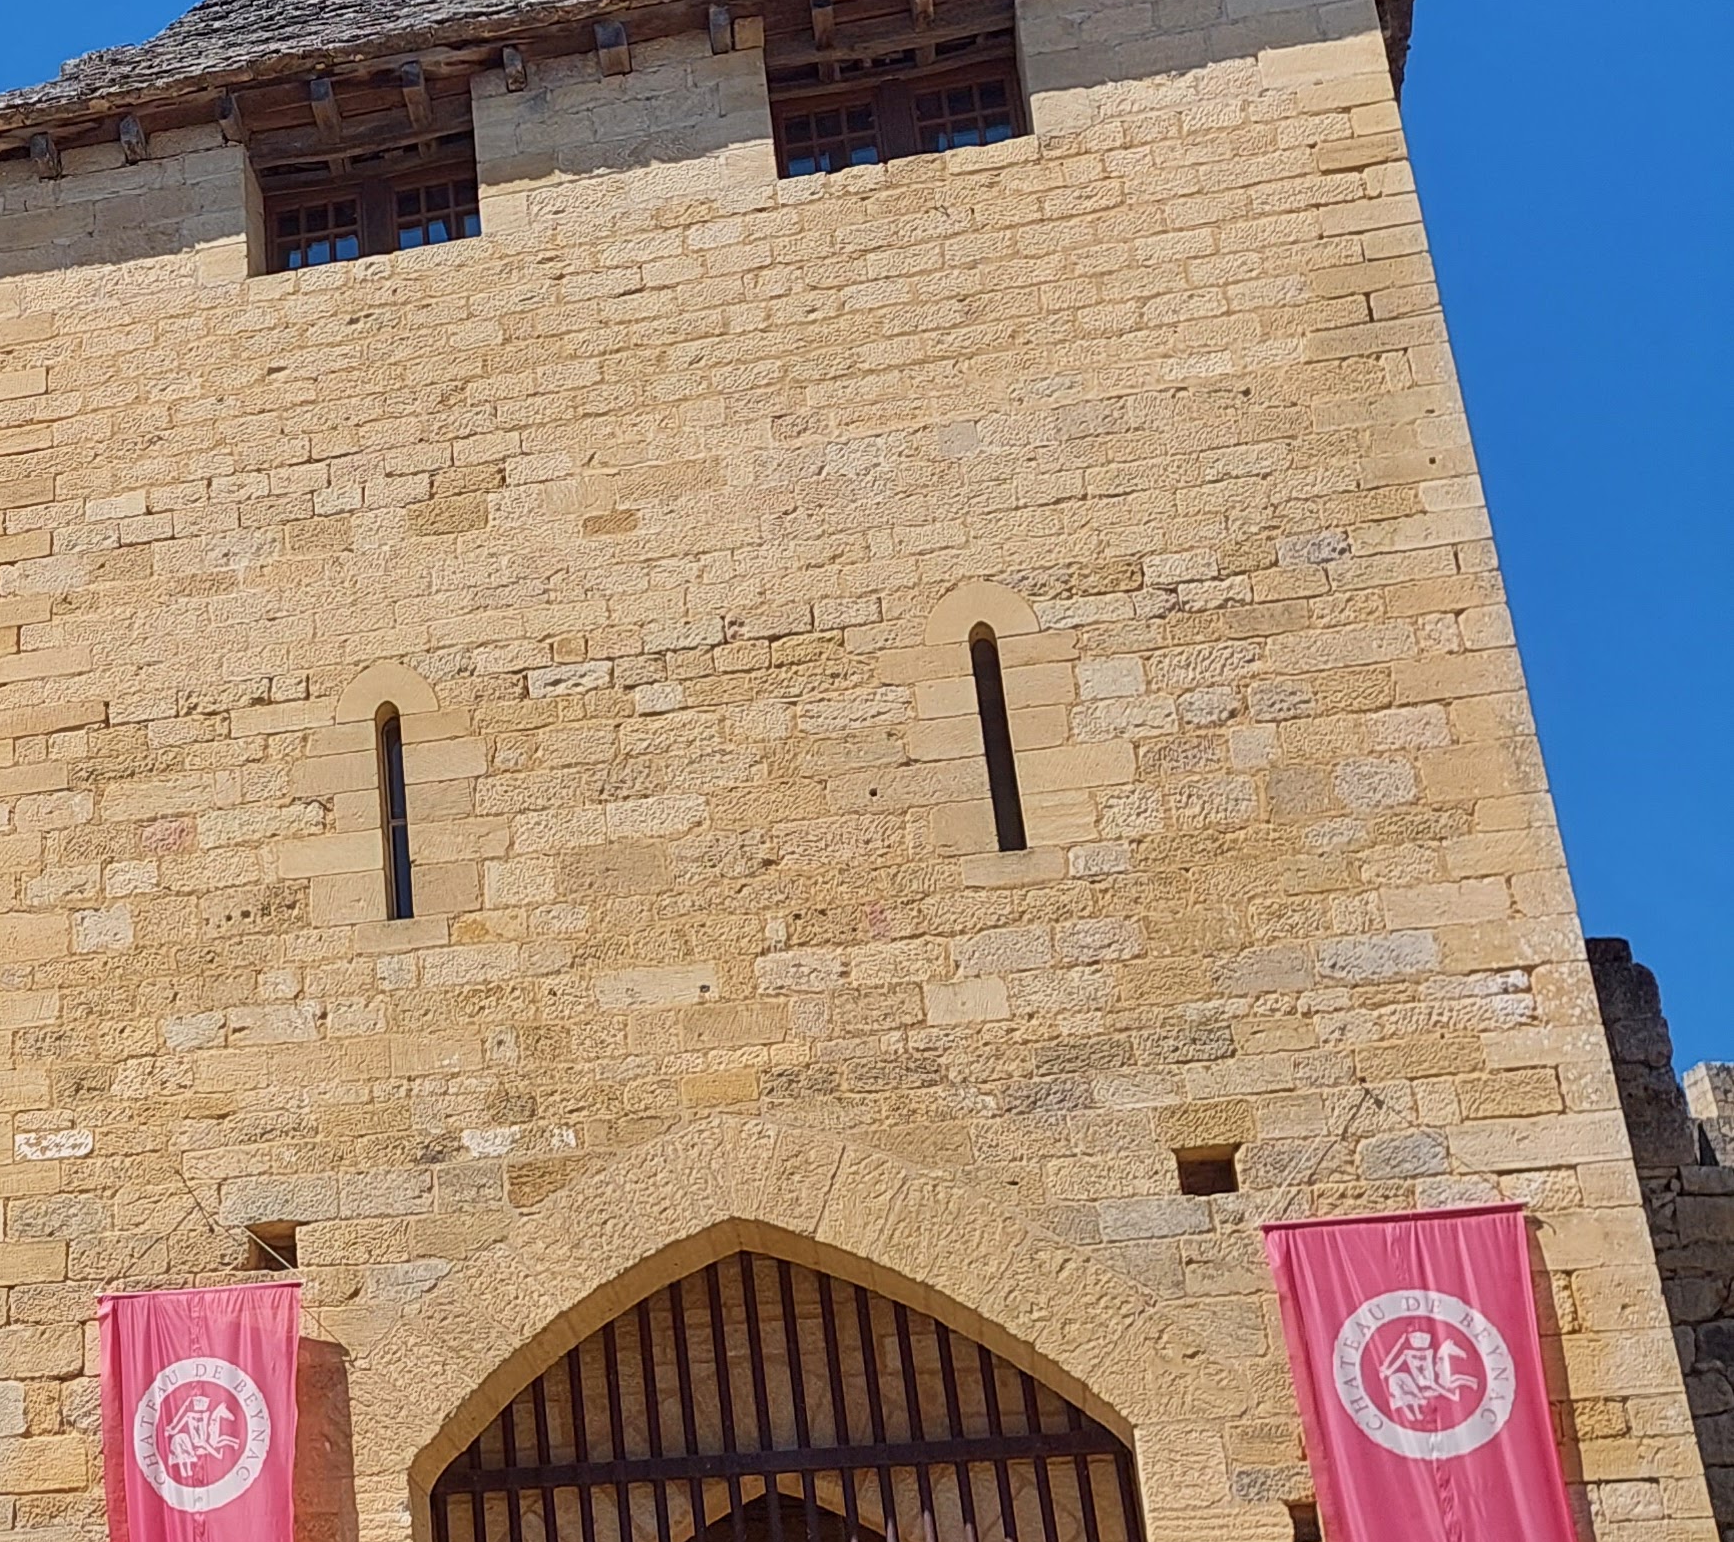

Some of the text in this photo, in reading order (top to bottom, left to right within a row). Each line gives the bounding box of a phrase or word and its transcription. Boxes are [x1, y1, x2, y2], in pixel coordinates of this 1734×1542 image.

[195, 1363, 224, 1380] DE
[233, 1379, 266, 1482] BEYNAC
[1340, 1296, 1509, 1431] CHATEAU DE BEYNAC
